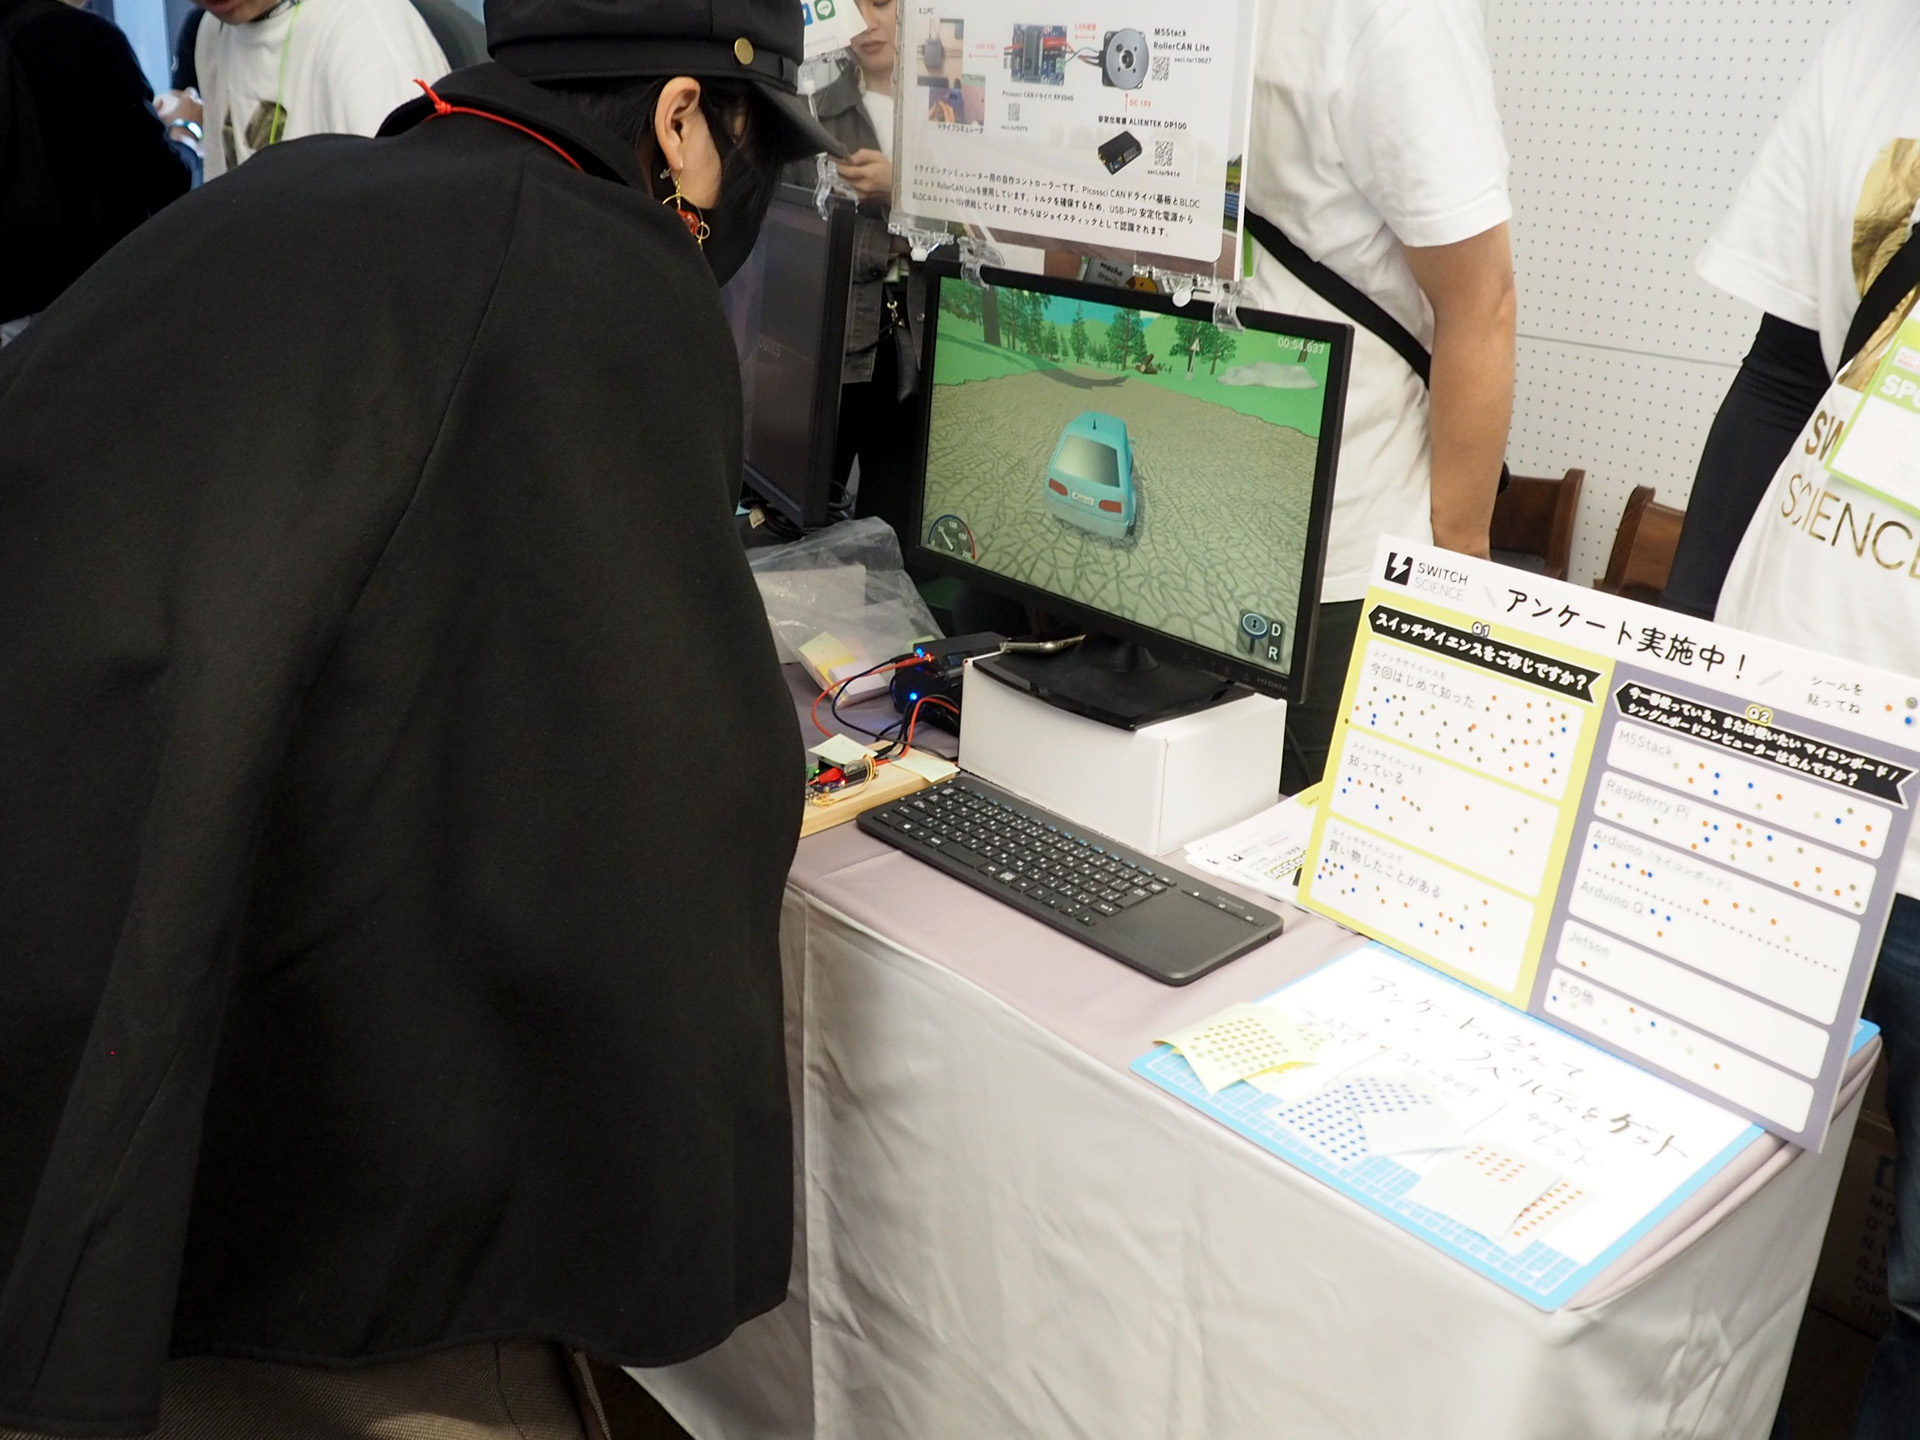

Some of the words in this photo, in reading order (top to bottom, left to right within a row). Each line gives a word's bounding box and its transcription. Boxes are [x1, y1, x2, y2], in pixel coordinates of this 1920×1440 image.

[1154, 28, 1187, 37] M5Stack
[1153, 42, 1193, 51] RollerCAN
[1194, 43, 1210, 52] Lite
[1128, 118, 1162, 128] ALIENTEK
[1163, 121, 1187, 130] DP100
[1417, 562, 1469, 586] SWITCH
[1413, 576, 1465, 602] SCIENCE
[1271, 622, 1281, 637] D
[1472, 621, 1490, 638] Q1
[1268, 645, 1278, 660] R
[1371, 661, 1475, 710] 今回はじめて知った
[1811, 675, 1863, 696] シールを
[1748, 706, 1771, 723] Q2
[1807, 692, 1861, 715] 貼ってね
[1619, 729, 1673, 758] M5Stack
[1348, 753, 1404, 785] 知っている
[1605, 778, 1672, 816] Raspberry
[1675, 803, 1690, 819] Pi
[1593, 828, 1644, 858] Arduino
[1579, 880, 1630, 911] Arduino
[1632, 900, 1645, 915] Q
[1567, 930, 1610, 957] Jetson
[1557, 977, 1595, 1006] その他
